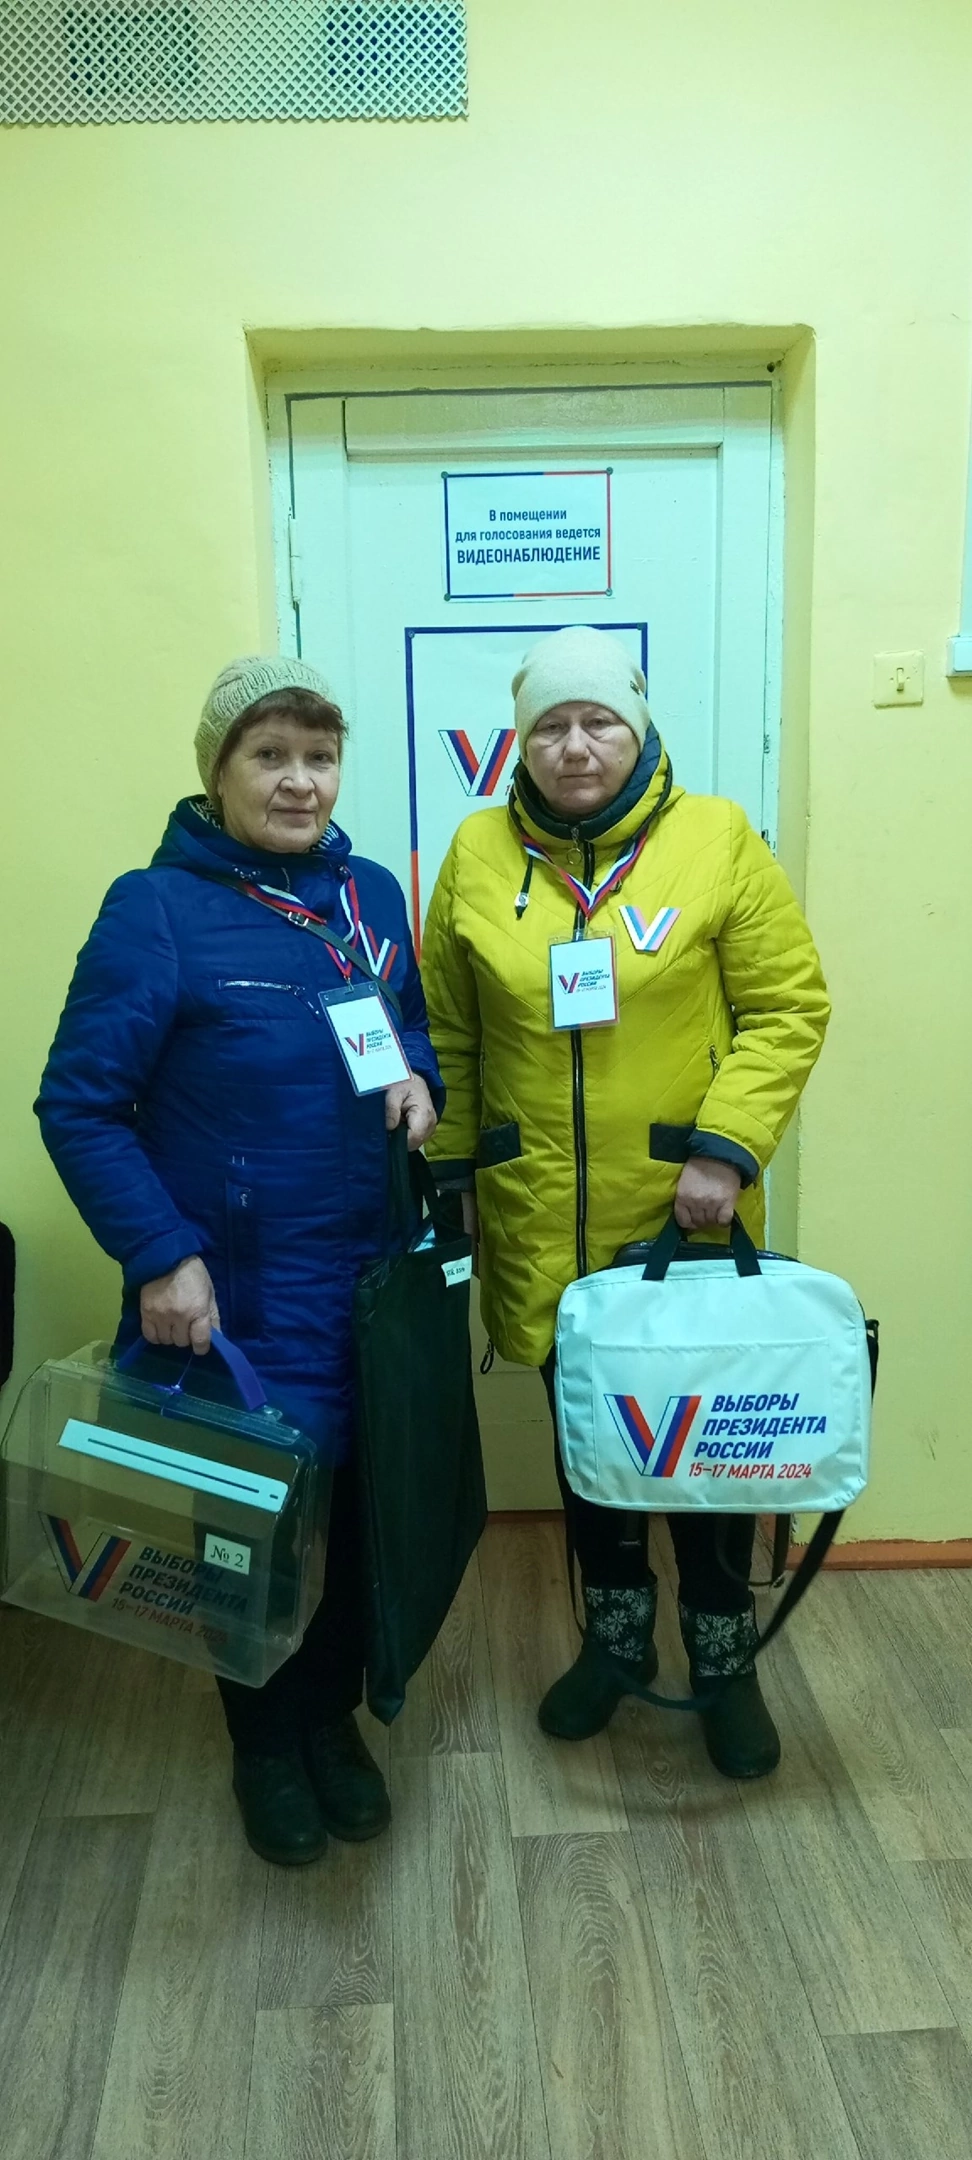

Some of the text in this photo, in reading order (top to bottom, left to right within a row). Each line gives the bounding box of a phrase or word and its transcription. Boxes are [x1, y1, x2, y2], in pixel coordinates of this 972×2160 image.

[489, 509, 567, 522] В помещении
[455, 528, 601, 543] для голосования ведется
[457, 546, 601, 565] ВИДЕОНАБЛЮДЕНИЕ
[711, 1393, 800, 1412] ВЫБОРЫ
[702, 1416, 827, 1437] ПРЕЗИДЕНТА
[694, 1441, 774, 1459] РОССИИ
[727, 1464, 776, 1479] МАРТА
[776, 1463, 812, 1478] 2024
[138, 1546, 223, 1583] ВЫБОРЫ
[210, 1544, 244, 1568] № 2
[118, 1581, 195, 1616] РОССИИ
[128, 1564, 248, 1614] ПРЕЗИДЕНТА
[148, 1609, 194, 1633] МАРТА
